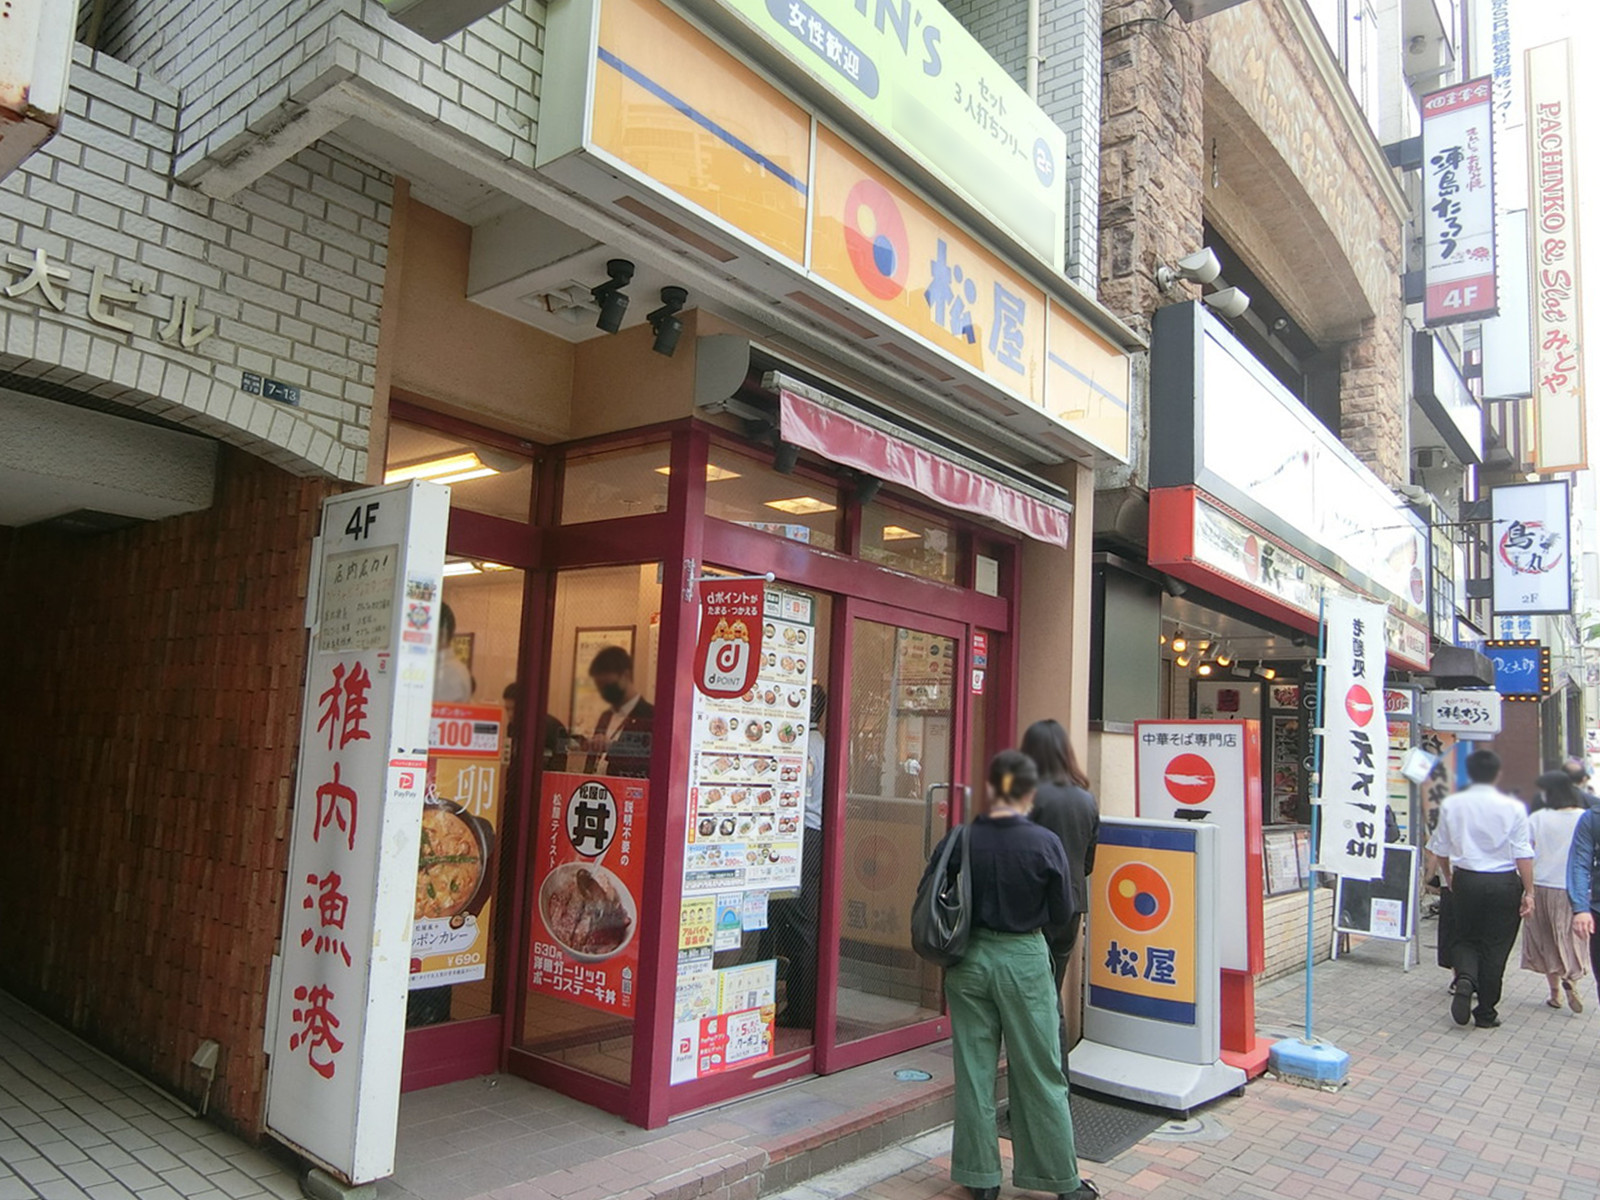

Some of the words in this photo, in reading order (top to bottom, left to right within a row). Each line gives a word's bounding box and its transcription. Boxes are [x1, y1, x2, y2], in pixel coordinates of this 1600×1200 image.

[788, 3, 861, 81] 女性歓迎
[846, 0, 942, 77] N'S
[977, 77, 1006, 117] セット
[954, 82, 1028, 161] 3人打ちフリー
[1036, 148, 1052, 176] 2F
[1539, 101, 1566, 231] PACHINKO
[1430, 145, 1465, 260] 浦島たろう
[1544, 238, 1567, 263] &
[4, 247, 215, 348] 大ビル
[924, 238, 1026, 376] 松屋
[1443, 285, 1478, 309] 4F
[1541, 329, 1577, 394] みとや
[267, 382, 298, 401] 7-13
[345, 502, 380, 541] 4F
[707, 591, 758, 604] dポイントが
[707, 606, 758, 616] たまる・つかえる
[1522, 593, 1538, 604] 2F
[1142, 732, 1237, 748] 中華そば専門店
[393, 790, 417, 799] PayPay
[424, 783, 441, 806] &
[579, 786, 608, 800] 松屋の
[290, 661, 372, 1080] 稚内漁港
[447, 952, 481, 966] ¥690
[1104, 941, 1177, 986] 松屋
[532, 971, 617, 1005] ポークステーキ丼
